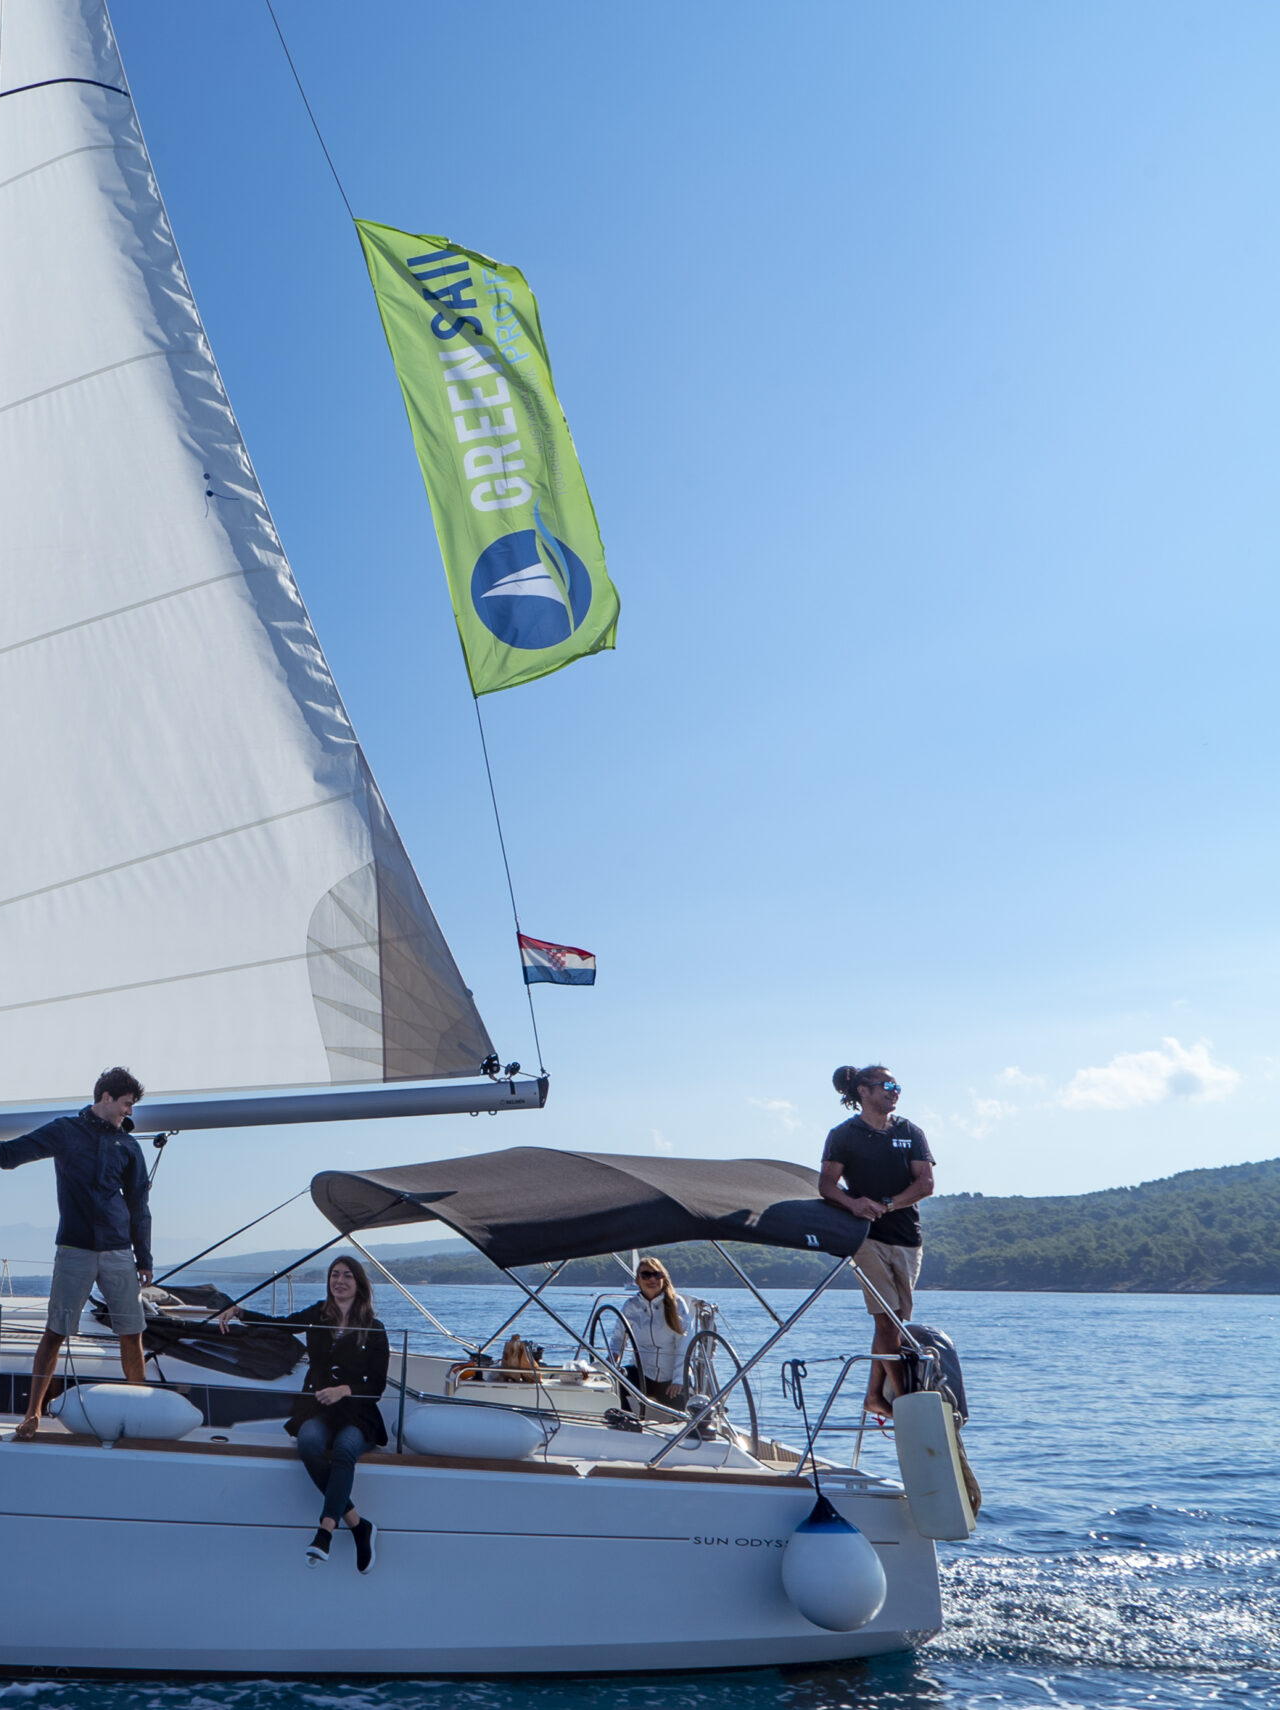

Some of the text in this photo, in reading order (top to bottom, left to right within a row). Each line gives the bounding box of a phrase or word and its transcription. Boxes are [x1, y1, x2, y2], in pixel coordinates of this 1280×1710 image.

[439, 344, 533, 512] GREEN
[547, 439, 568, 497] TOURISM
[693, 1536, 729, 1545] SUN
